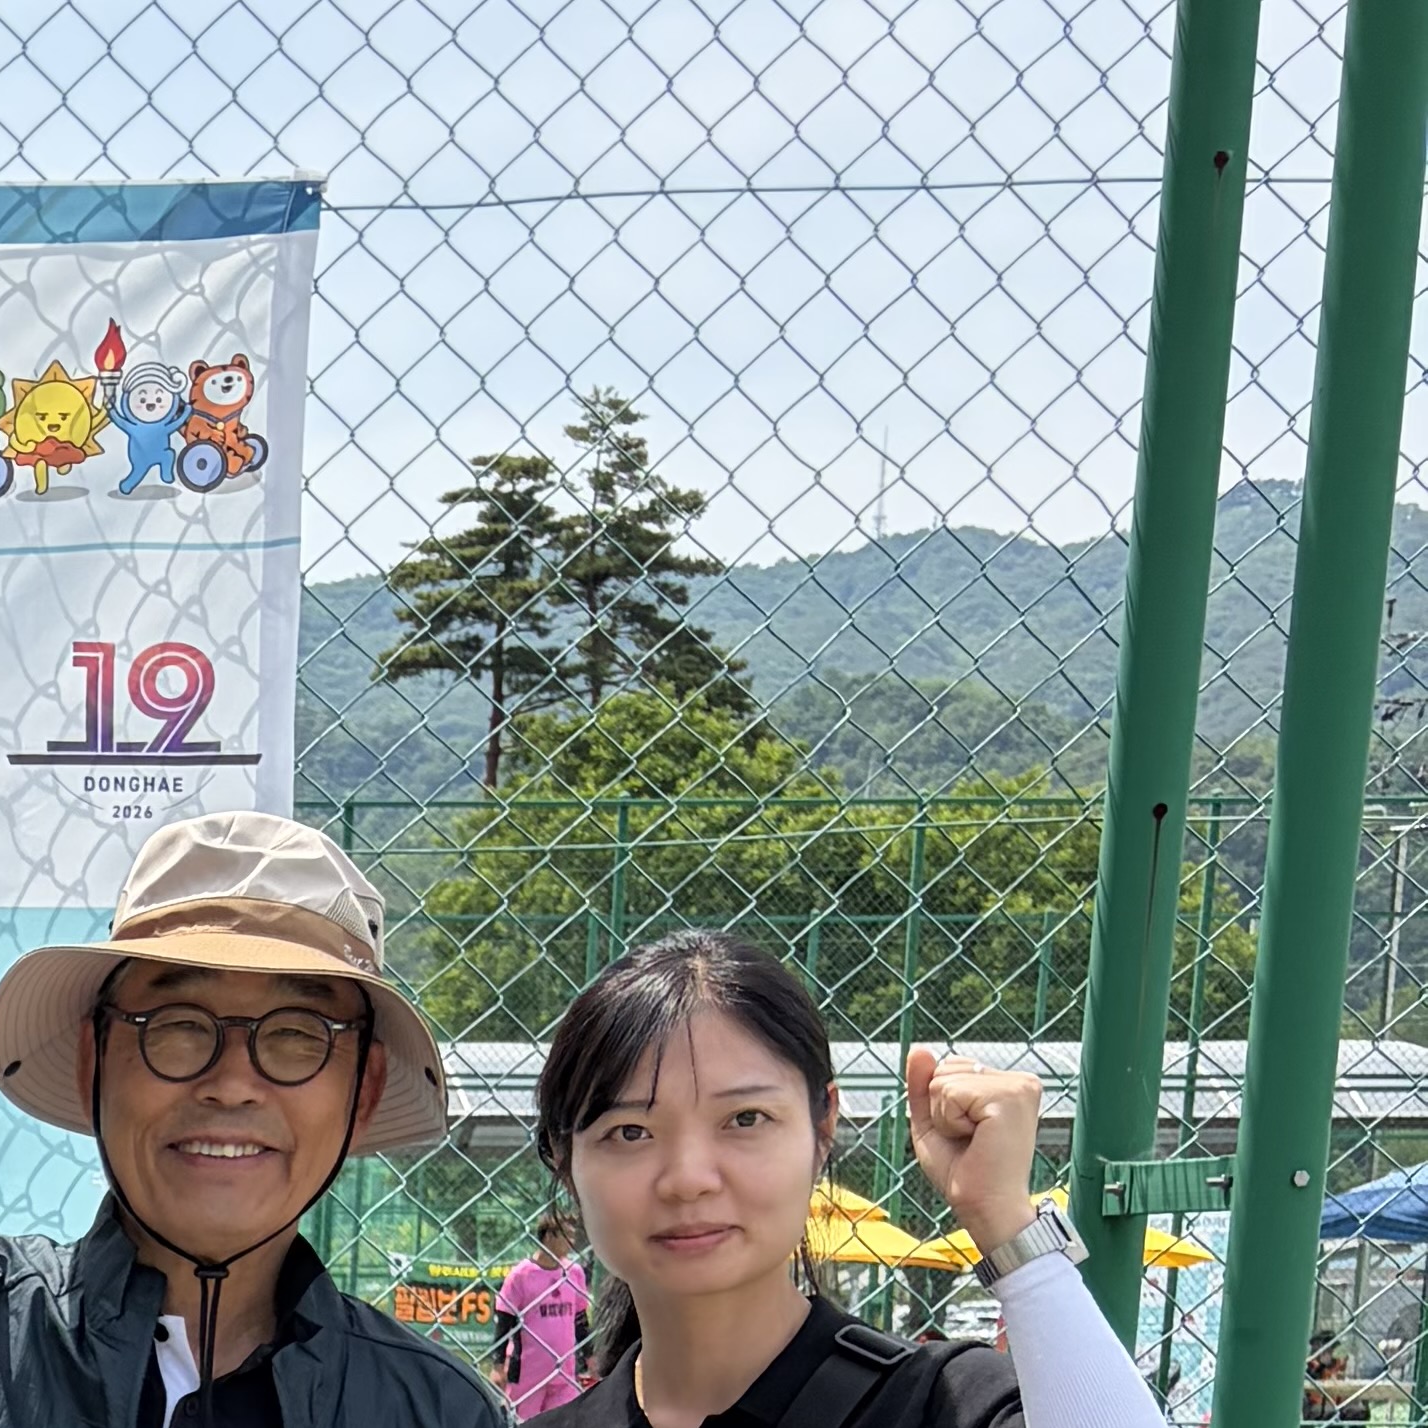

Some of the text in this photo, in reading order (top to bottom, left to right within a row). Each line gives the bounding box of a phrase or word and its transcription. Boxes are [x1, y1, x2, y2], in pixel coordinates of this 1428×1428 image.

[47, 641, 221, 753] 19
[83, 774, 184, 794] DONGHAE
[112, 804, 154, 820] 2026
